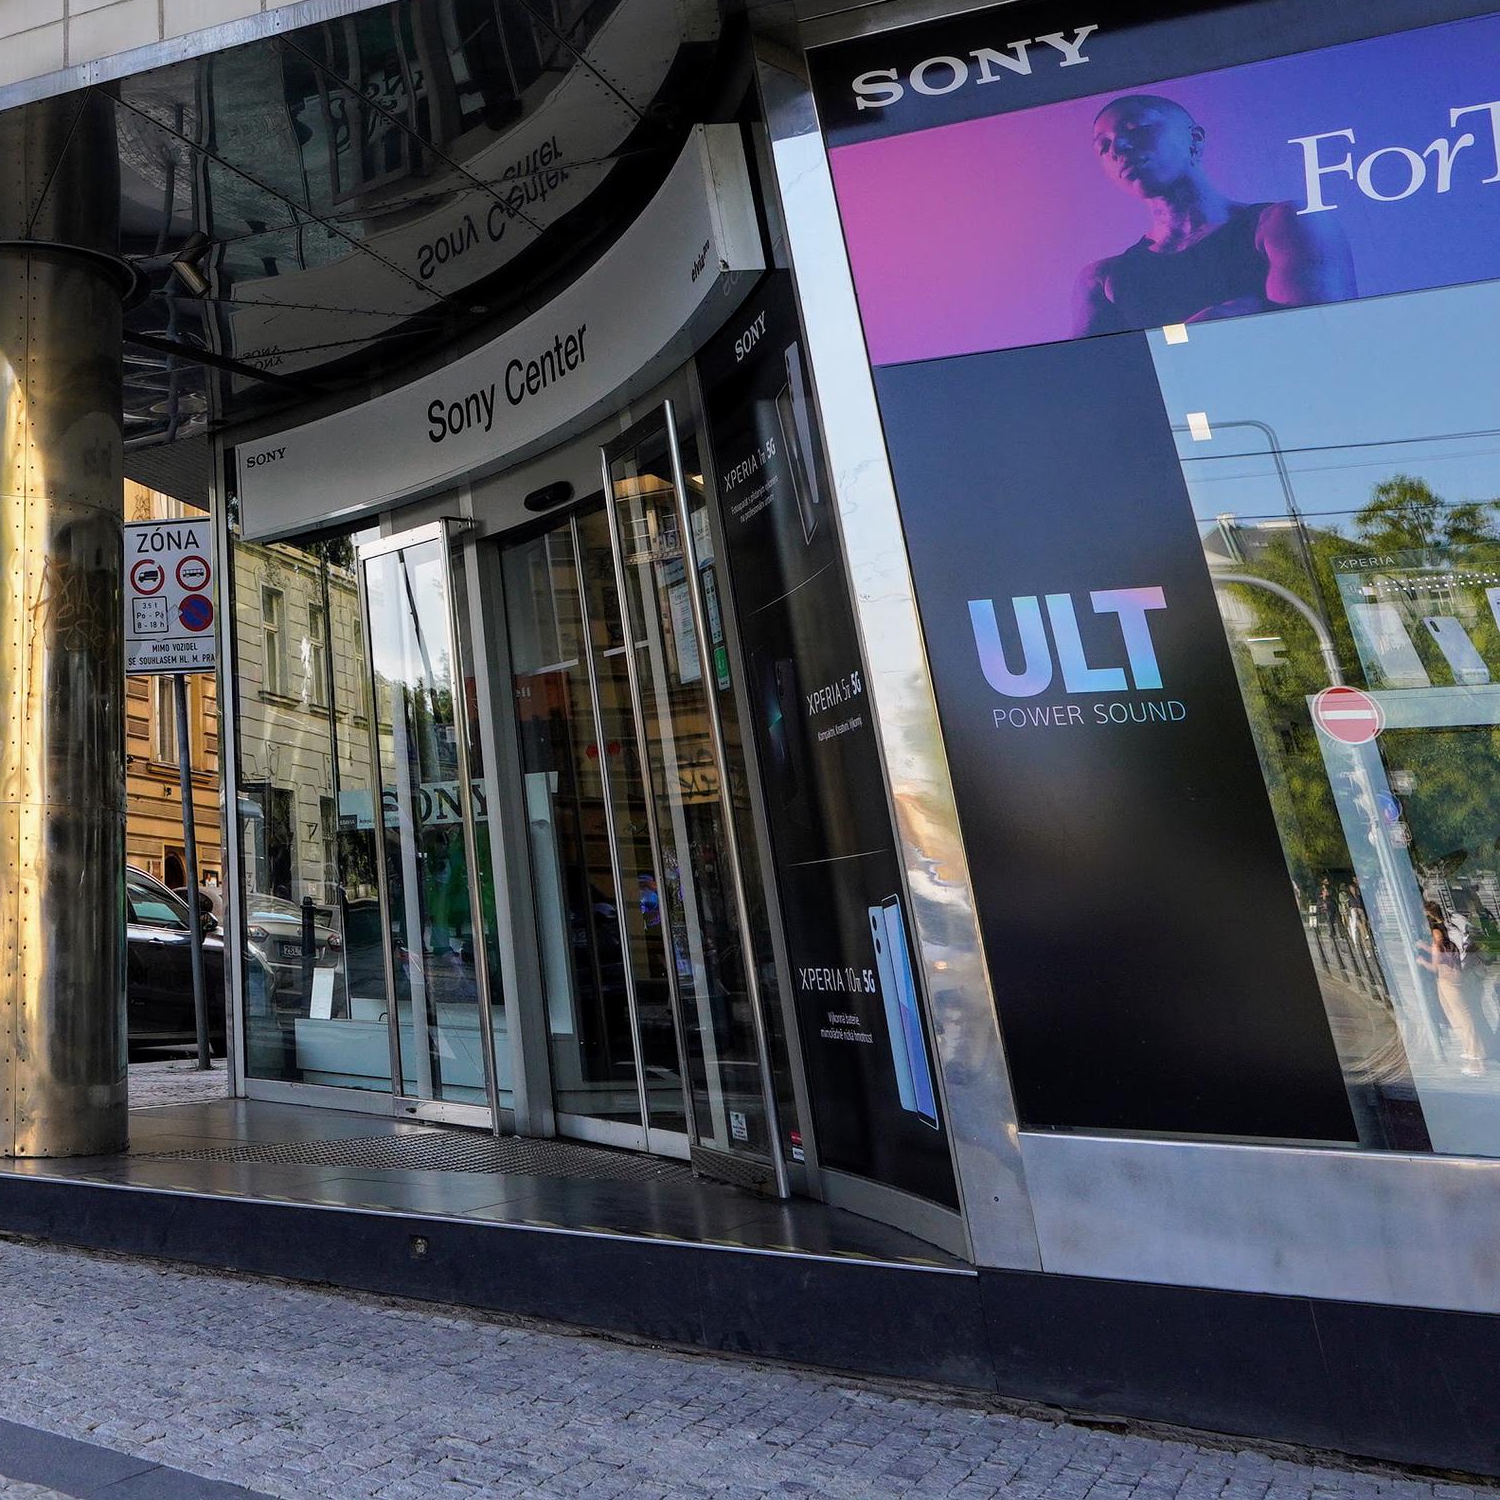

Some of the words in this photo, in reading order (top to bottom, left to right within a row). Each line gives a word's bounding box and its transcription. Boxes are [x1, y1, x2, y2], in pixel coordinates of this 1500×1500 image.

[852, 23, 1099, 111] SONY
[734, 310, 766, 363] SONY
[428, 383, 495, 443] Sony
[504, 324, 587, 406] Center
[246, 447, 287, 470] SONY
[723, 454, 758, 493] XPERIA
[765, 437, 776, 459] 5G
[136, 527, 200, 553] ZÓNA
[1338, 555, 1395, 569] XPERIA
[152, 643, 170, 653] MIMO
[172, 642, 198, 651] VOZIDEL
[967, 586, 1168, 698] ULT
[128, 657, 136, 666] SE
[139, 654, 177, 666] SOUHLASEM
[179, 654, 189, 663] HL.
[806, 682, 842, 716] XPERIA
[850, 670, 862, 695] 5G
[992, 705, 1085, 729] POWER
[1093, 700, 1186, 725] SOUND
[799, 968, 845, 991] XPERIA
[862, 969, 876, 994] 5G
